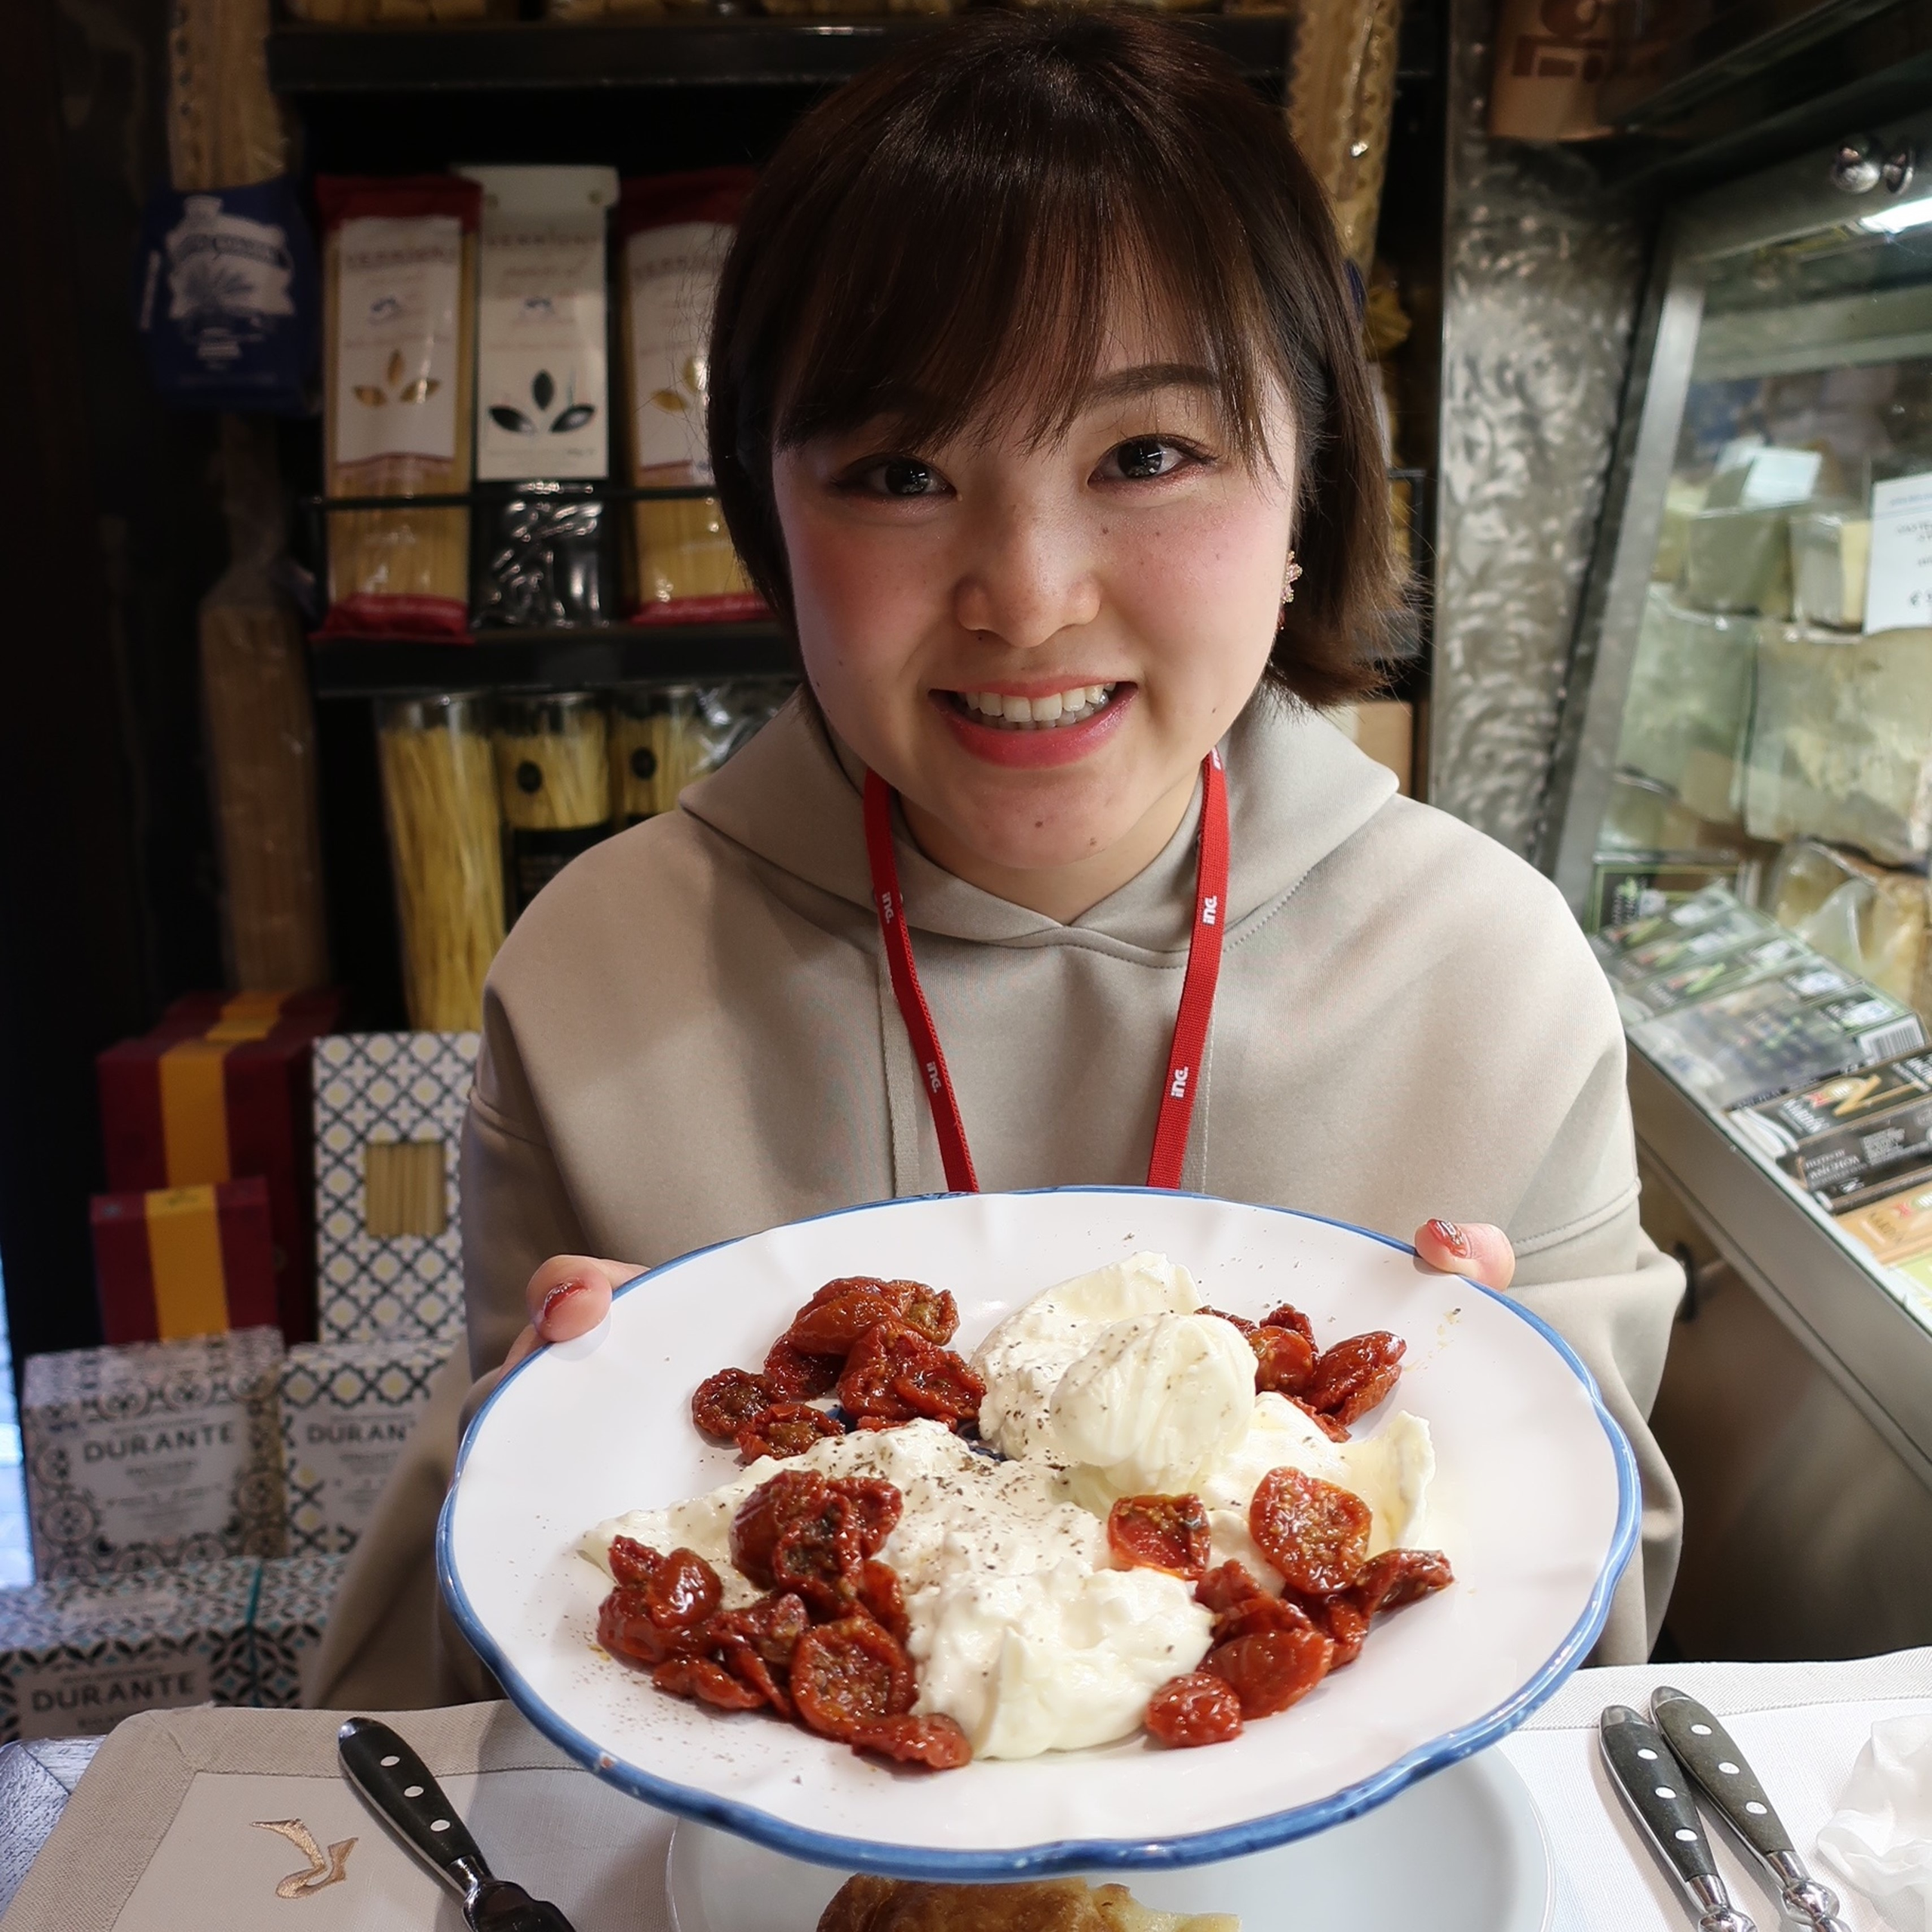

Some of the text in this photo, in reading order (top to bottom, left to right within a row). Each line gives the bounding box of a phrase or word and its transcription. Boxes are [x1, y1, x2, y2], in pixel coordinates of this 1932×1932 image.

[1203, 895, 1217, 925] inc.
[1171, 1066, 1189, 1098] inc.
[83, 1422, 232, 1464] DURANTE
[306, 1421, 415, 1444] DURAN
[32, 1671, 193, 1712] DURANTE
